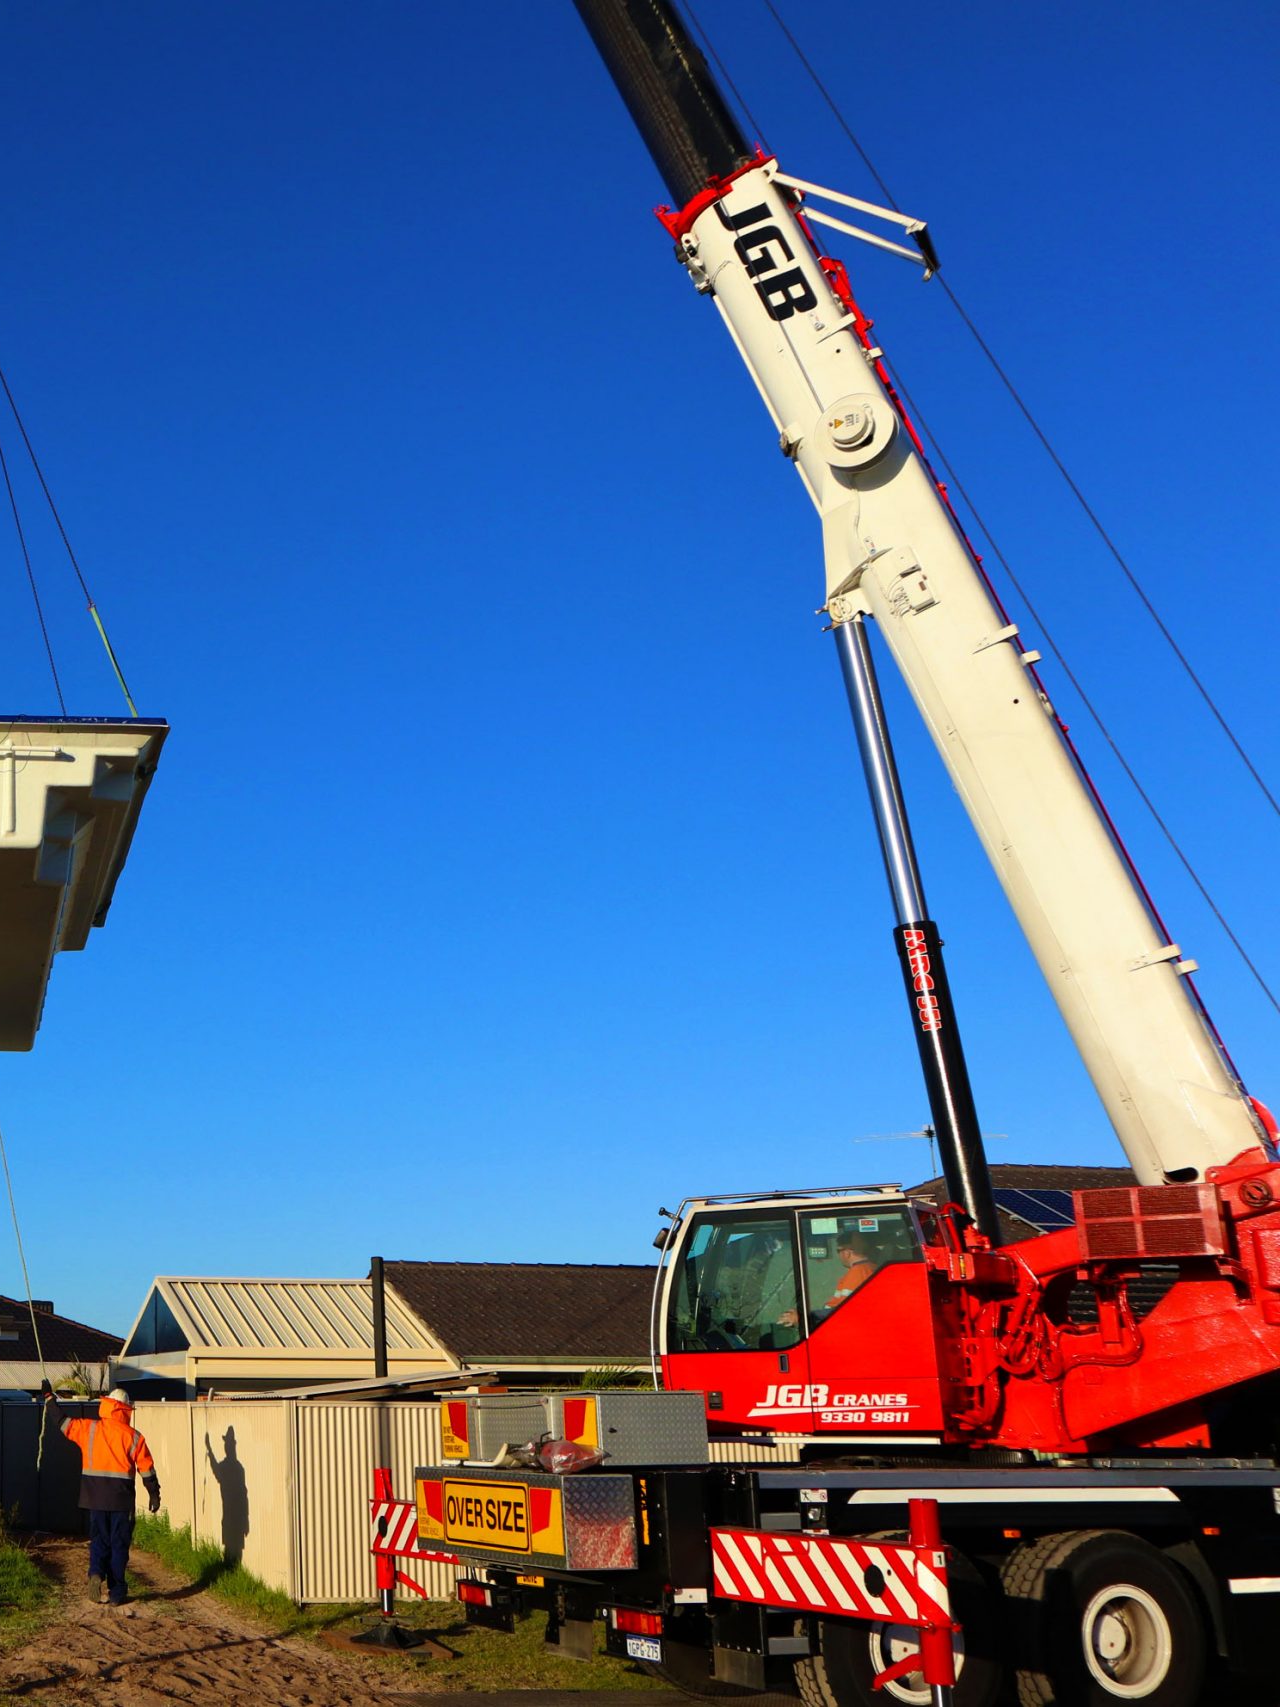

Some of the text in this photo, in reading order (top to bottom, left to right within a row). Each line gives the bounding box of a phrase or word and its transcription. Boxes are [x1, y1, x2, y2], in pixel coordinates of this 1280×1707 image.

[713, 201, 817, 321] JGB
[903, 930, 934, 992] MRC
[756, 1384, 908, 1407] JGB CRANES
[821, 1411, 909, 1423] 9330 9811
[447, 1495, 525, 1532] OVERSIZE
